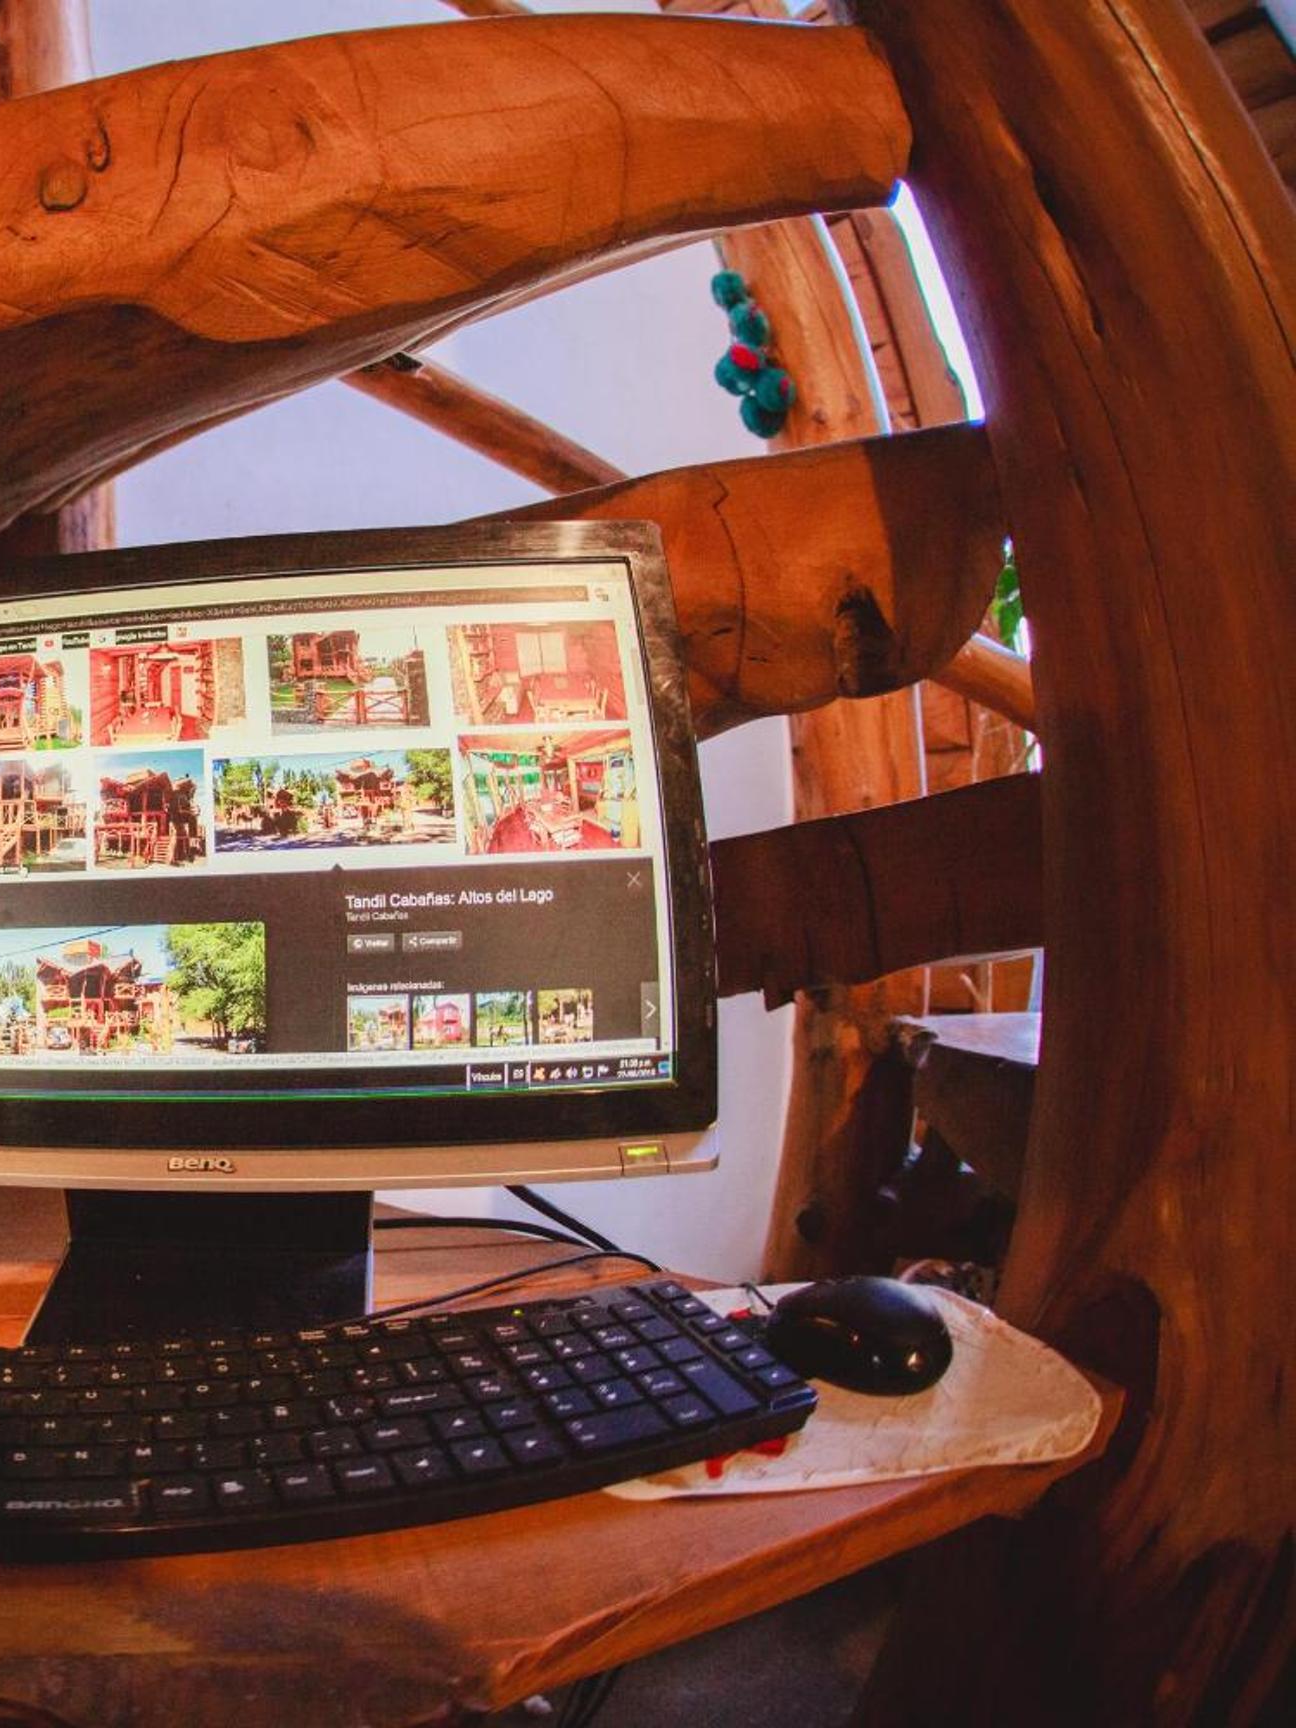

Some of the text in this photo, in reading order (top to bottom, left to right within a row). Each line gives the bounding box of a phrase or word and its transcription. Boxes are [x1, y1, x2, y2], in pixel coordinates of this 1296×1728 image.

[344, 888, 554, 909] Tandil Cabañas: Altos del Lago
[168, 1156, 235, 1173] BenQ
